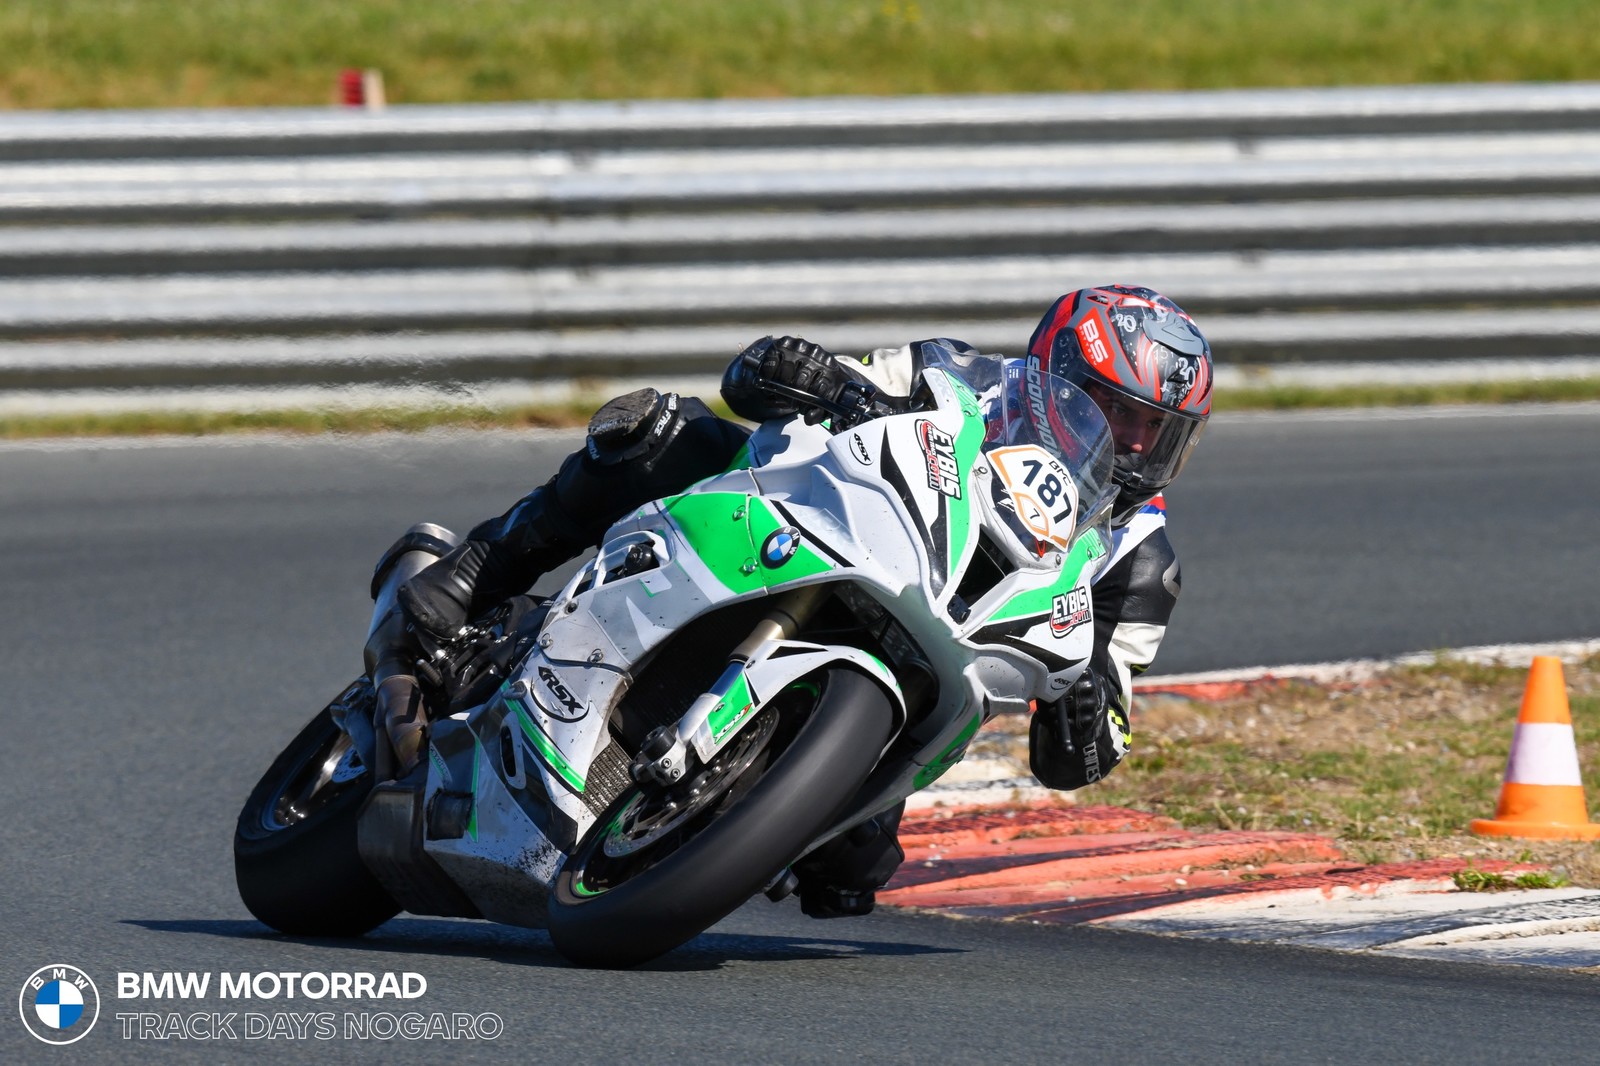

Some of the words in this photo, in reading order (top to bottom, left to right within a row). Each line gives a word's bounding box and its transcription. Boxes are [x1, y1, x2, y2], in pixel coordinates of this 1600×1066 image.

[1082, 318, 1109, 363] BS
[934, 428, 961, 500] EYBIS
[1022, 459, 1072, 524] 187
[1029, 508, 1041, 520] 7
[1053, 586, 1089, 619] EYBIS
